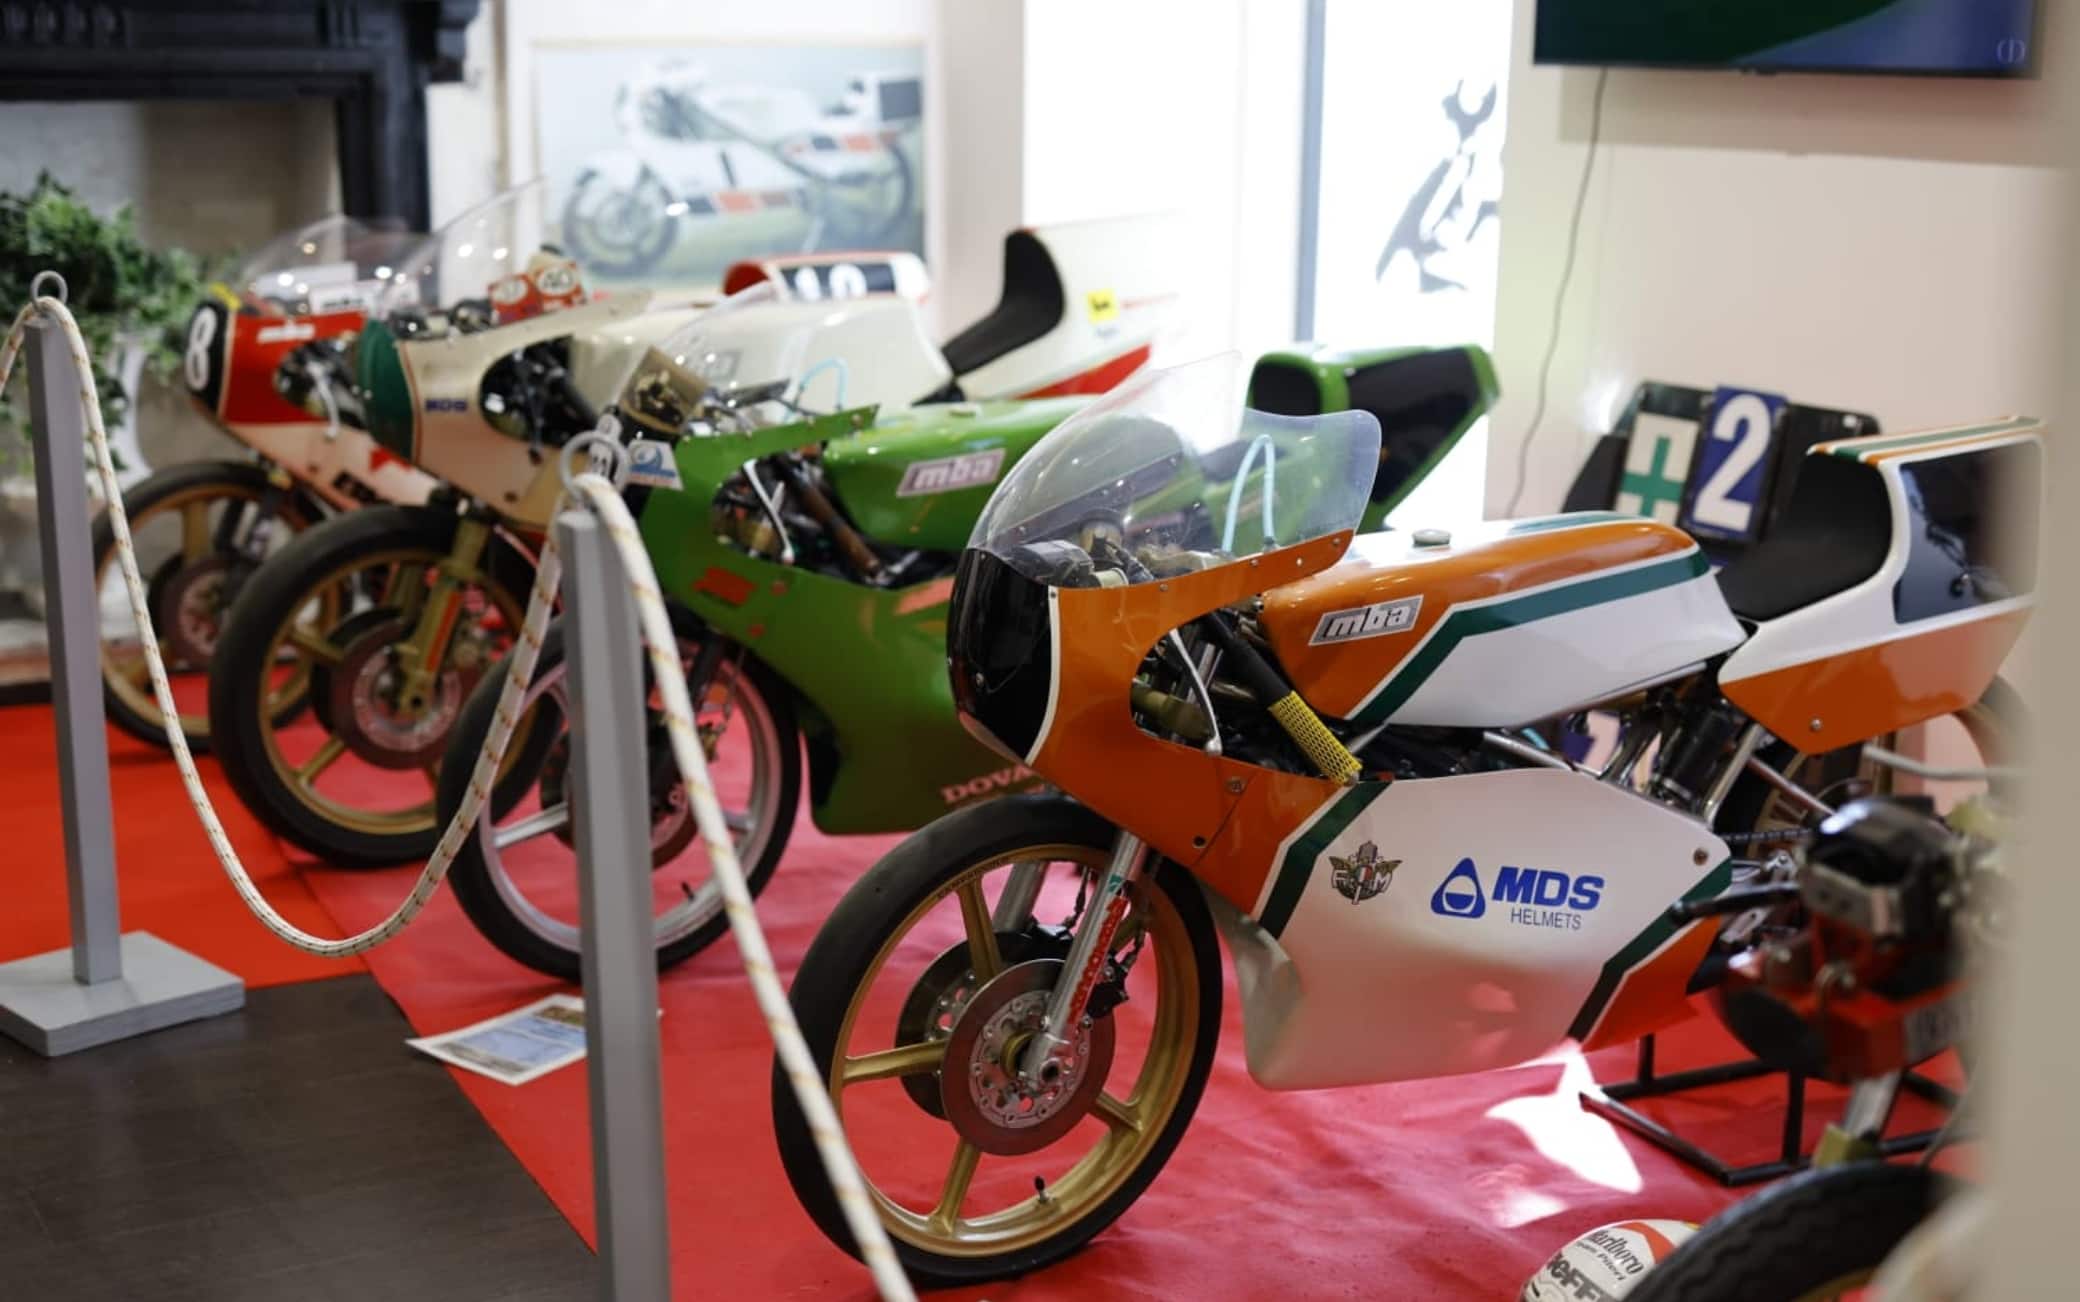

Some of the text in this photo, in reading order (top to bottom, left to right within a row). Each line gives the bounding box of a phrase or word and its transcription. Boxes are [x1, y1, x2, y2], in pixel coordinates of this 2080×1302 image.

[184, 306, 217, 391] 8
[912, 458, 994, 490] mba
[1694, 393, 1772, 532] 2
[1323, 605, 1411, 638] mba
[1491, 866, 1606, 911] MDS
[1510, 907, 1583, 931] HELMETS
